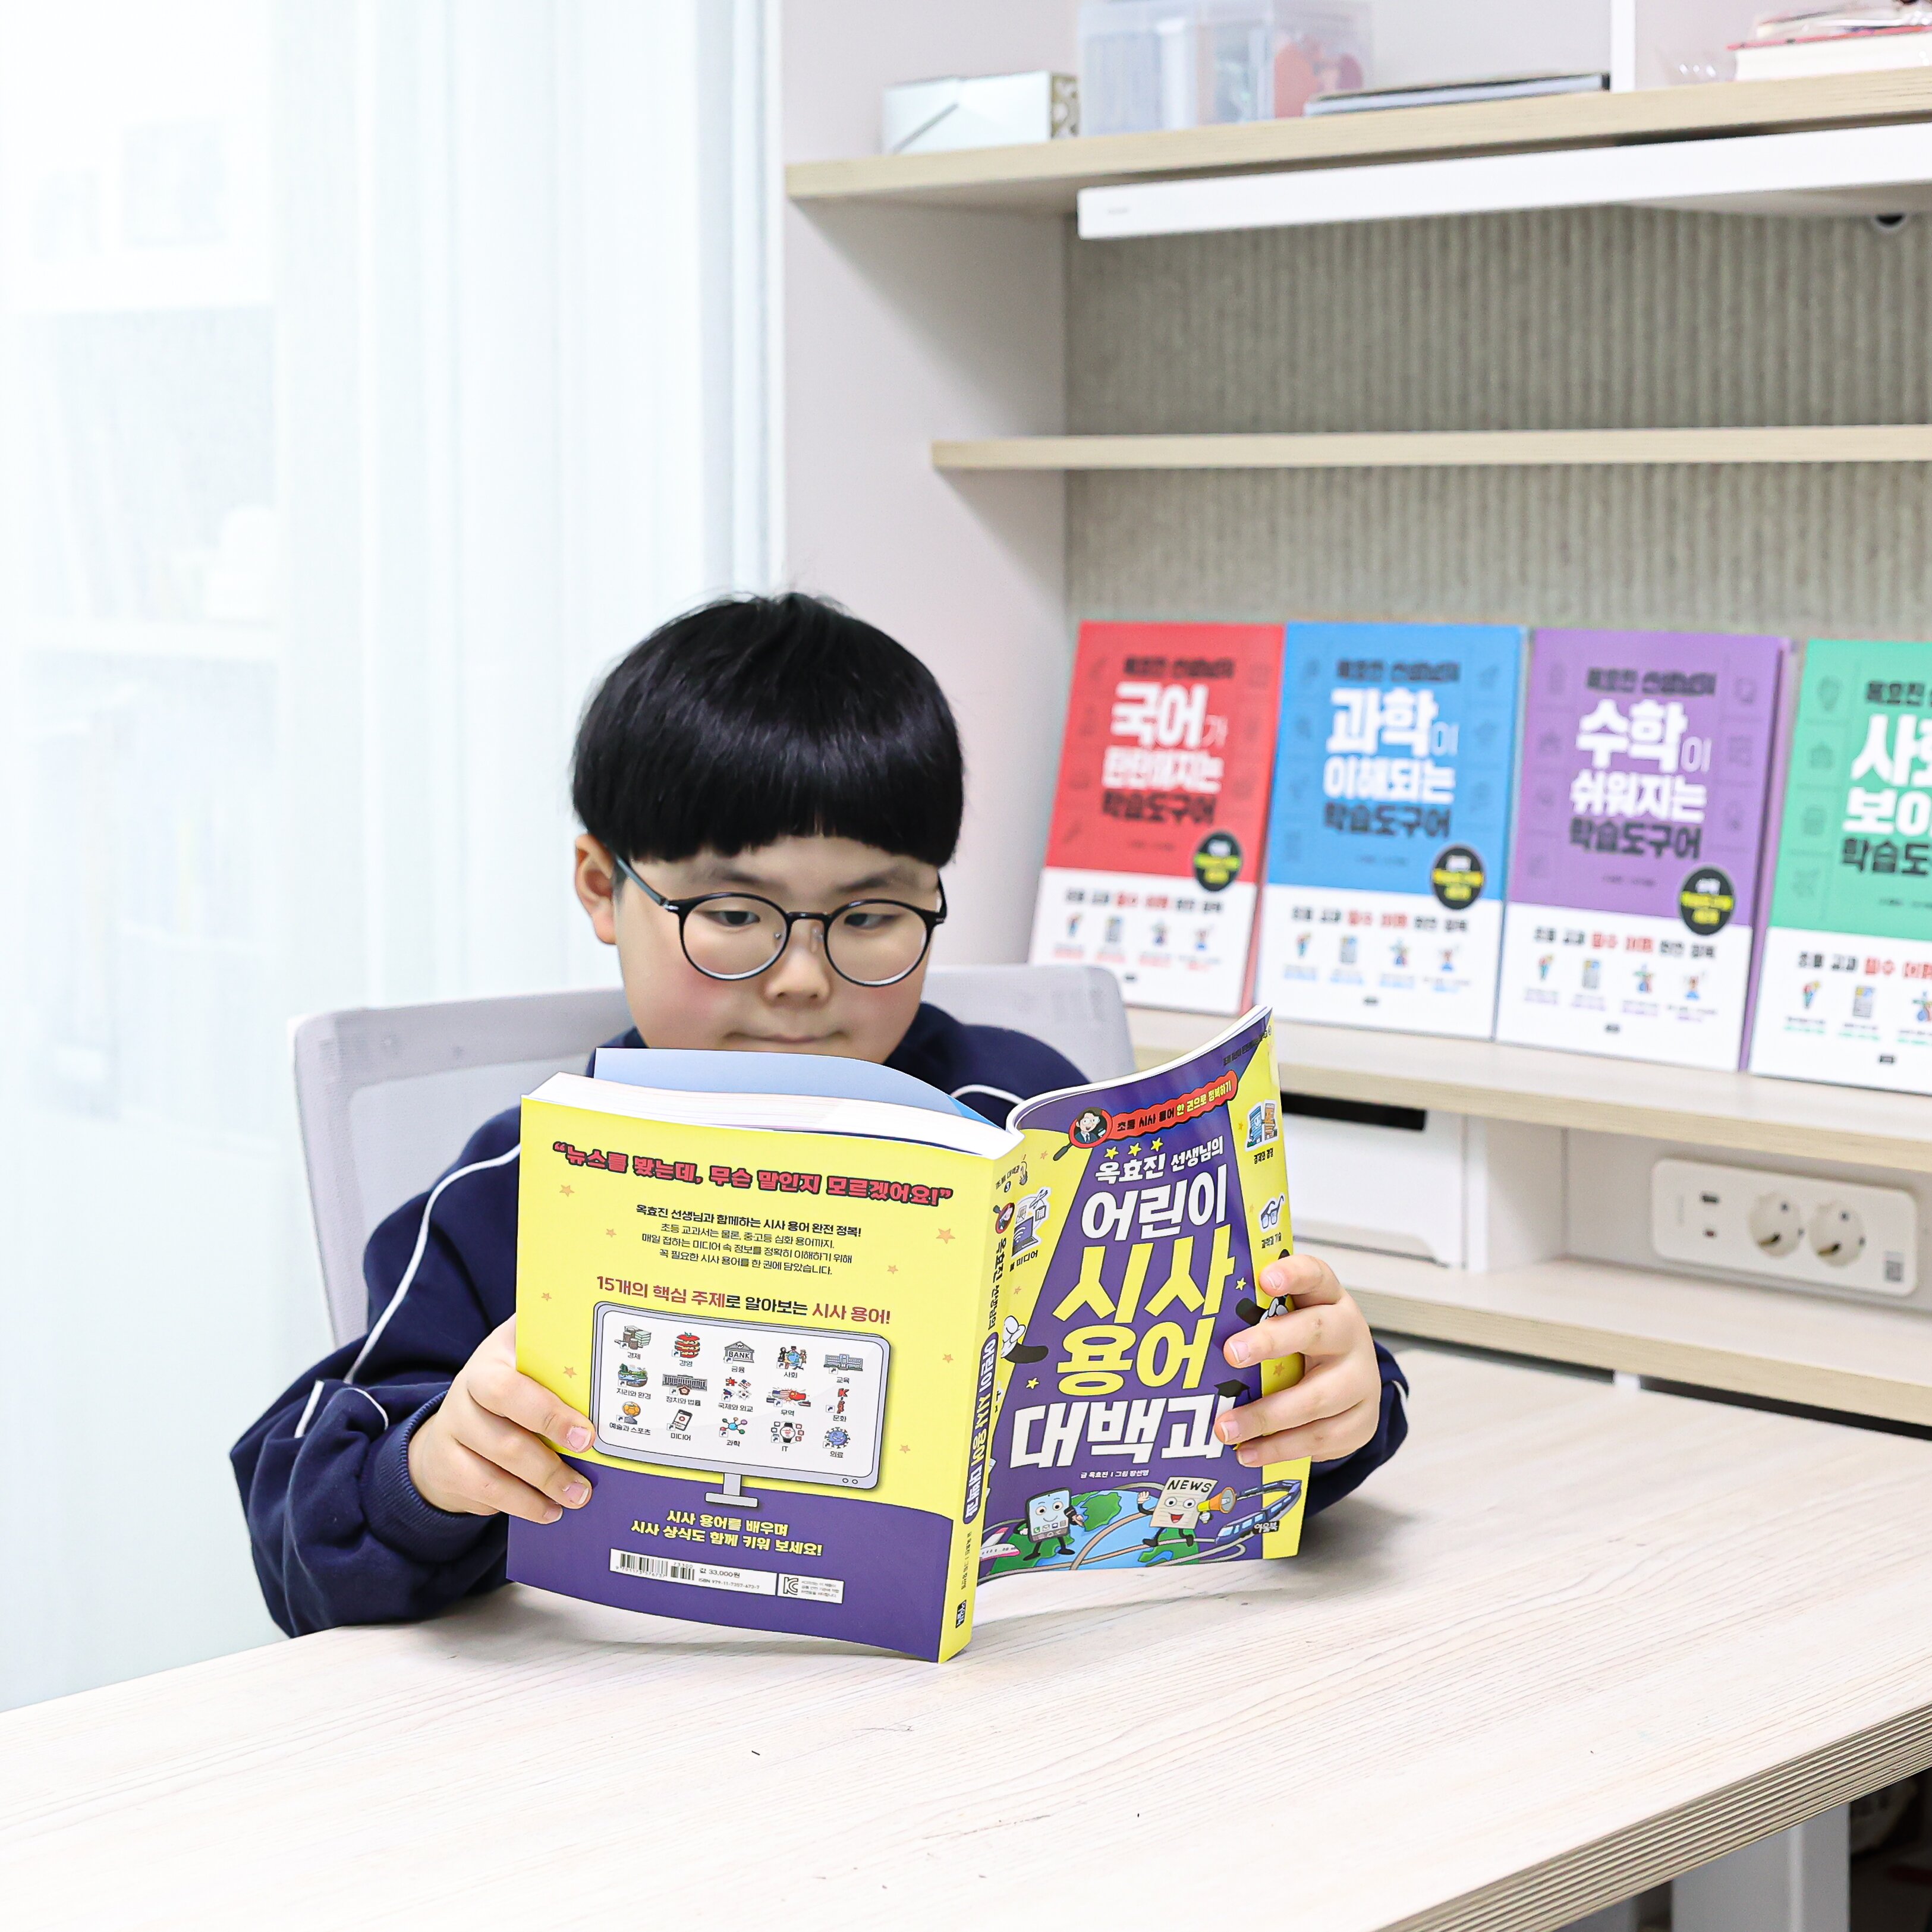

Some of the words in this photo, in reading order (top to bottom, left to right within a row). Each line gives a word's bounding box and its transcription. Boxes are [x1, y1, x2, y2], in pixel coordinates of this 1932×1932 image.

[1110, 681, 1229, 749] 국어가
[1326, 687, 1459, 757] 과학이
[1576, 698, 1711, 773] 수학이
[1323, 756, 1456, 805] 이해되는
[1569, 769, 1707, 823] 쉬워지는
[1117, 1119, 1135, 1131] 초등
[1139, 1113, 1156, 1128] 시사
[1159, 1107, 1175, 1122] 용어
[1176, 1103, 1185, 1116] 한
[1187, 1094, 1207, 1112] 권으로
[1208, 1080, 1232, 1103] 정복하기
[553, 1141, 628, 1173] “뉴스를
[633, 1156, 703, 1184] 봤는데,
[709, 1165, 753, 1189] 무슨
[757, 1169, 822, 1194] 말인지
[826, 1175, 953, 1206] 모르겠어요!”
[1094, 1153, 1166, 1185] 옥효진
[1170, 1136, 1224, 1173] 선생님의
[636, 1204, 668, 1218] 옥효진
[671, 1209, 715, 1223] 선생님과
[716, 1214, 761, 1228] 함께하는
[763, 1219, 785, 1230] 시사
[788, 1221, 810, 1232] 용어
[812, 1223, 833, 1235] 완전
[836, 1225, 861, 1237] 정복!
[1081, 1163, 1227, 1241] 어린이
[642, 1233, 660, 1244] 매일
[663, 1236, 691, 1248] 접하는
[693, 1240, 720, 1251] 미디어
[723, 1244, 732, 1252] 속
[734, 1244, 762, 1255] 정보를
[764, 1247, 792, 1258] 정확히
[794, 1250, 832, 1261] 이해하기
[833, 1254, 852, 1263] 위해
[660, 1223, 679, 1234] 초등
[681, 1226, 719, 1238] 교과서는
[721, 1230, 741, 1240] 물론,
[775, 1235, 793, 1245] 심화
[795, 1237, 835, 1249] 용어까지.
[1017, 1250, 1038, 1266] 미디어
[659, 1249, 669, 1258] 꼭
[671, 1250, 698, 1261] 필요한
[701, 1254, 719, 1264] 시사
[722, 1256, 750, 1267] 용어를
[751, 1259, 762, 1268] 한
[763, 1260, 782, 1270] 권에
[784, 1262, 832, 1275] 담았습니다.
[1052, 1224, 1235, 1324] 시사
[596, 1276, 648, 1298] 15개의
[652, 1285, 687, 1304] 핵심
[691, 1290, 741, 1310] 주제로
[745, 1297, 808, 1316] 알아보는
[811, 1302, 847, 1320] 시사
[850, 1305, 891, 1324] 용어!
[978, 1338, 996, 1393] 어린이
[1057, 1316, 1216, 1396] 용어
[838, 1387, 849, 1398] K
[974, 1392, 991, 1430] 시사
[671, 1433, 691, 1441] 미디어
[970, 1428, 987, 1466] 용어
[964, 1465, 983, 1518] 대백과
[1167, 1479, 1212, 1493] NEWS
[631, 1520, 659, 1536] 시사
[663, 1525, 706, 1543] 상식도
[710, 1531, 738, 1547] 함께
[742, 1535, 770, 1551] 키워
[775, 1539, 823, 1557] 보세요!
[666, 1510, 696, 1525] 시사
[699, 1514, 742, 1531] 용어를
[746, 1519, 789, 1537] 배우며
